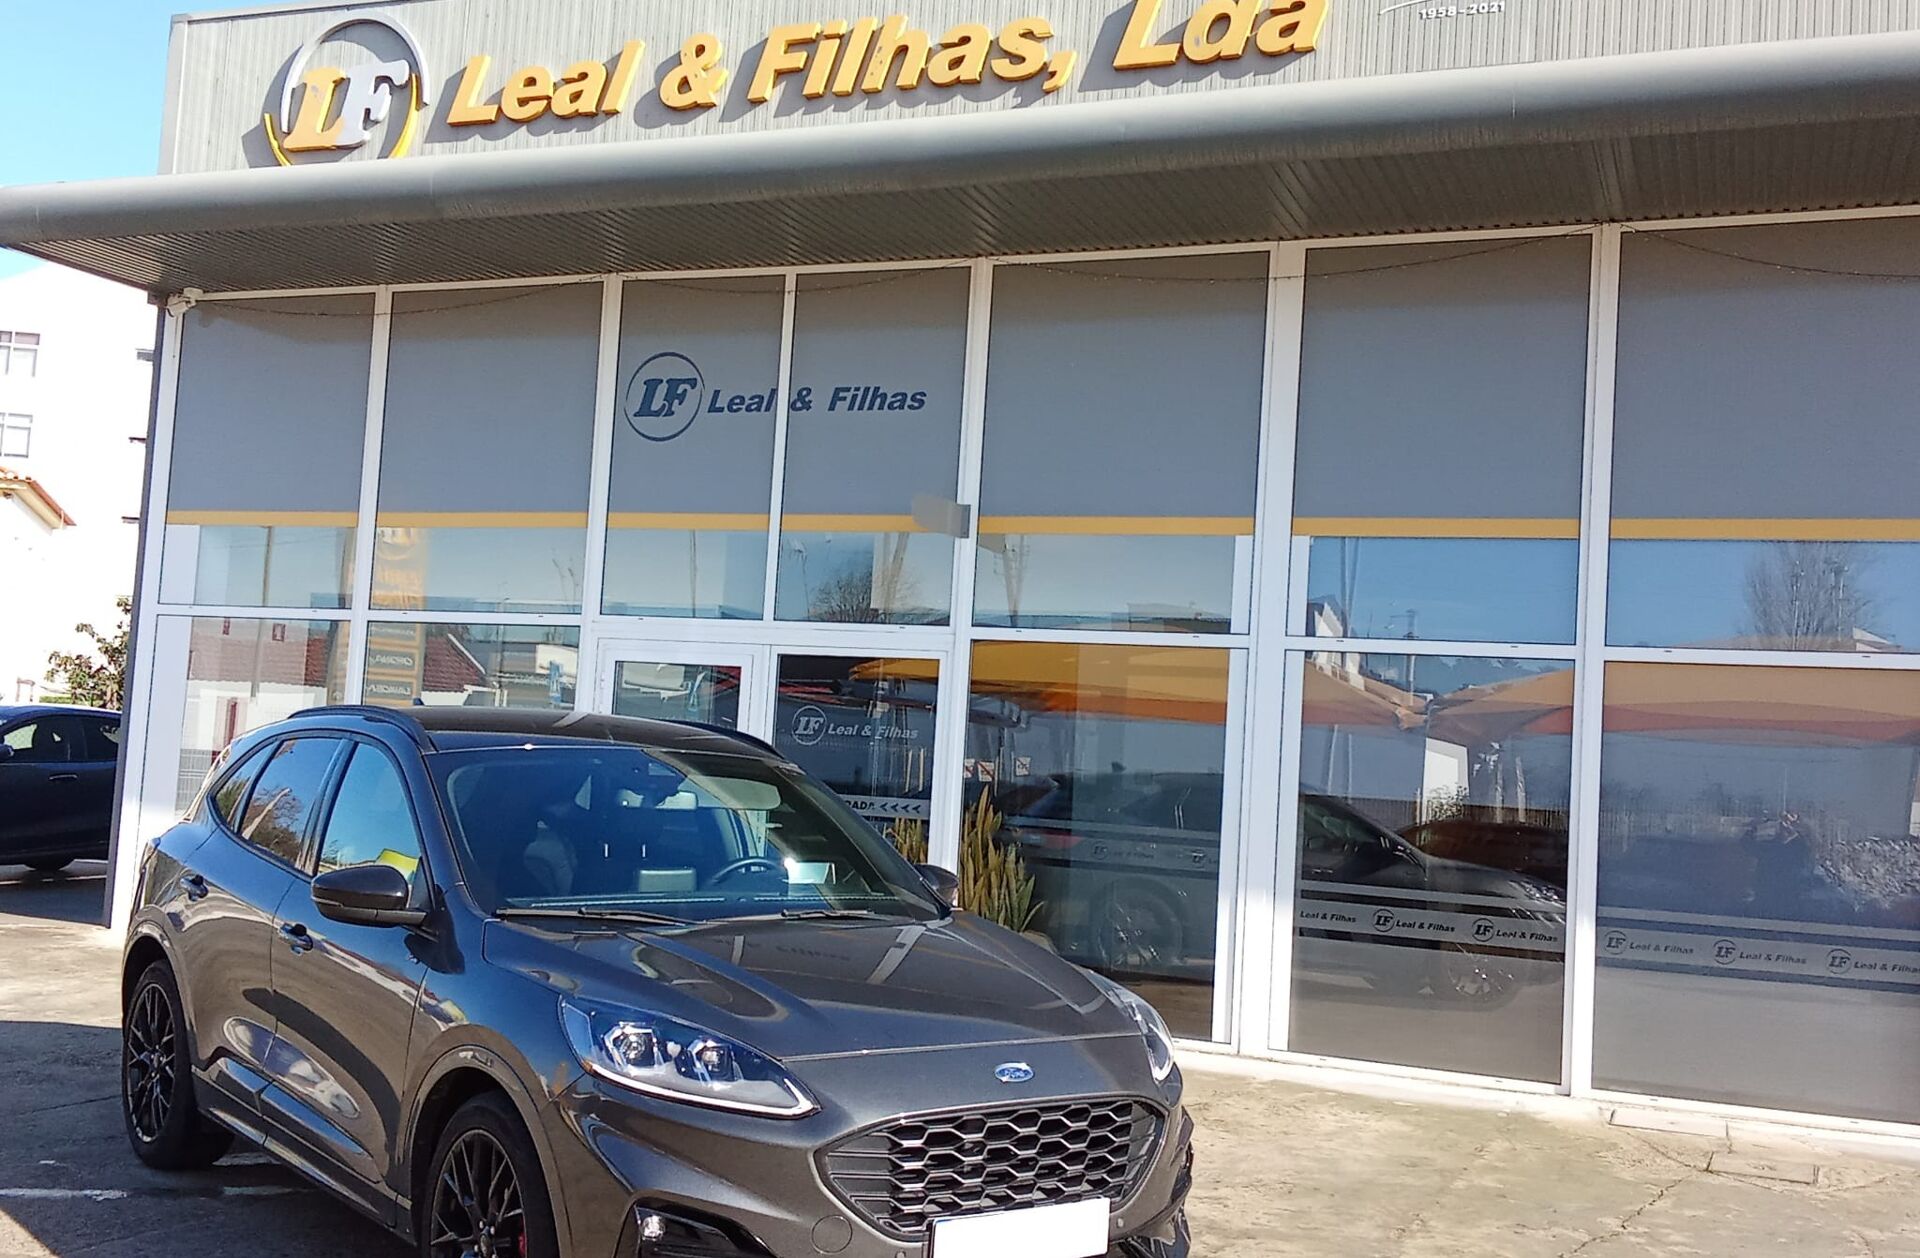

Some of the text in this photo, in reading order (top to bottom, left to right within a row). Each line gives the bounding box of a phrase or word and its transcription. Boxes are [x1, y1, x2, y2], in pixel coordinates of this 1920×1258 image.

[1419, 1, 1505, 19] 1958-2021
[446, 40, 645, 127] Leal
[659, 33, 728, 112] &
[747, 14, 1077, 103] Filhas,
[1113, 0, 1329, 71] Lda
[633, 377, 927, 417] LF Leal & Filhas
[795, 716, 919, 740] LF Leal & Filhas
[1300, 910, 1319, 919] Leal
[1330, 913, 1357, 923] Filhas
[1396, 919, 1416, 928] Leal
[1418, 921, 1425, 929] &
[1427, 923, 1455, 933] Filhas
[1529, 932, 1558, 942] Filhas
